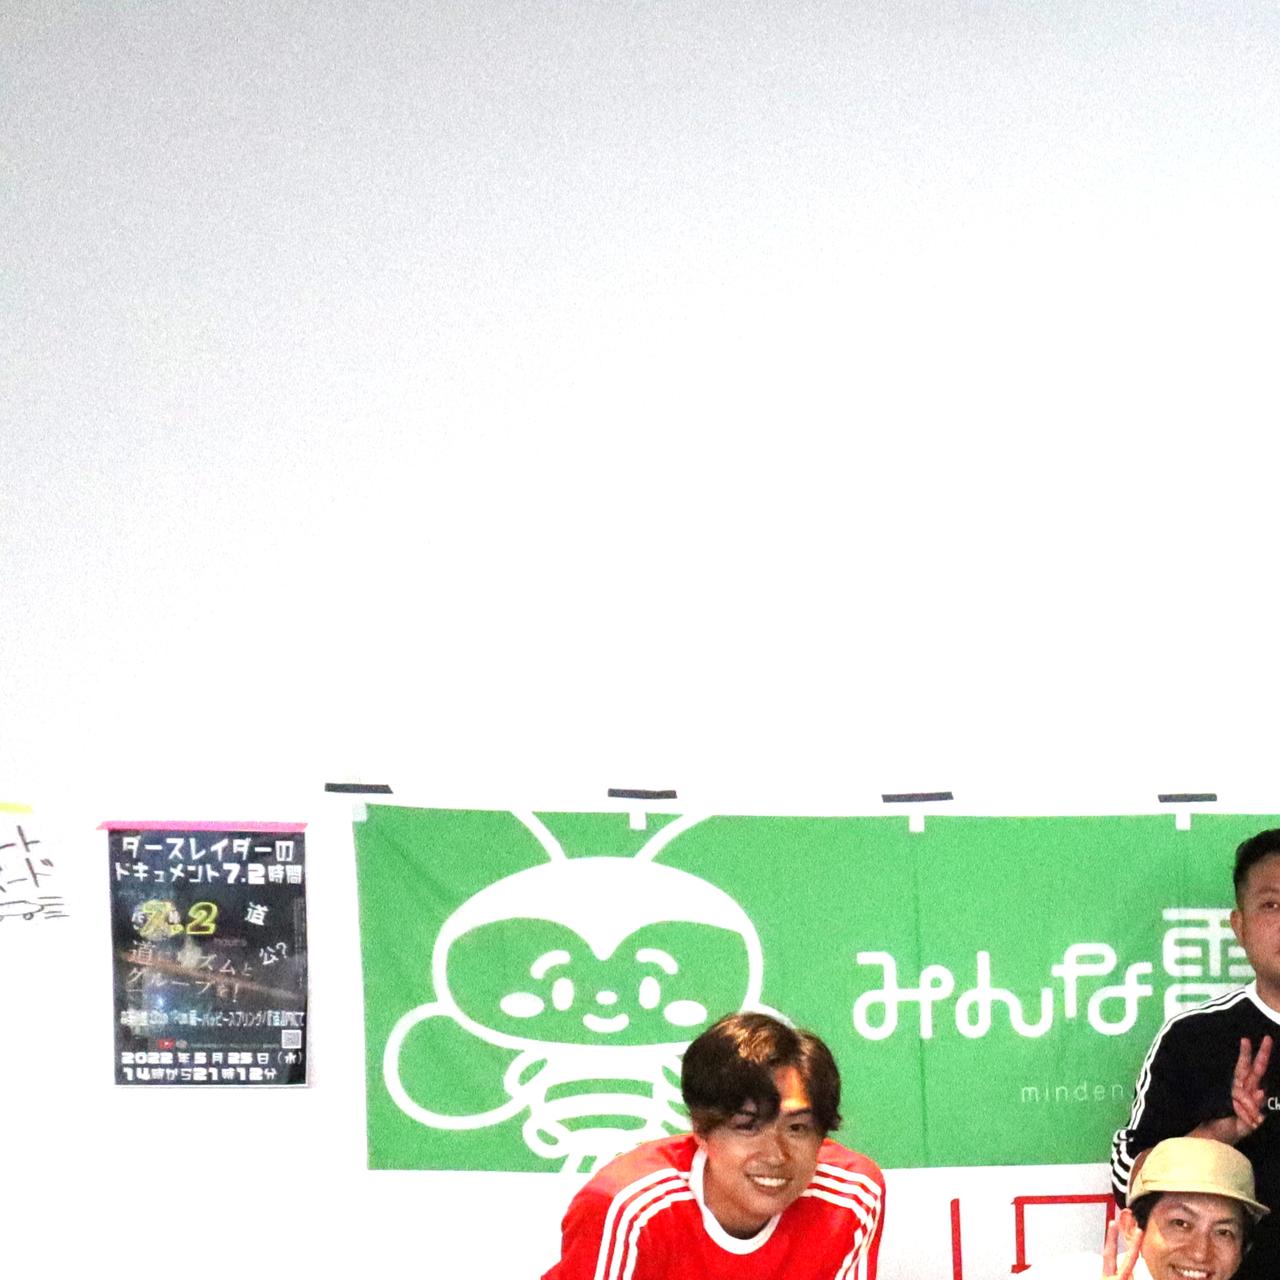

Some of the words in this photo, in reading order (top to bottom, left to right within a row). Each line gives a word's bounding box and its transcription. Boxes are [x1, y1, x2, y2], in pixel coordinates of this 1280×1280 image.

[121, 835, 295, 862] ダースレイダーの
